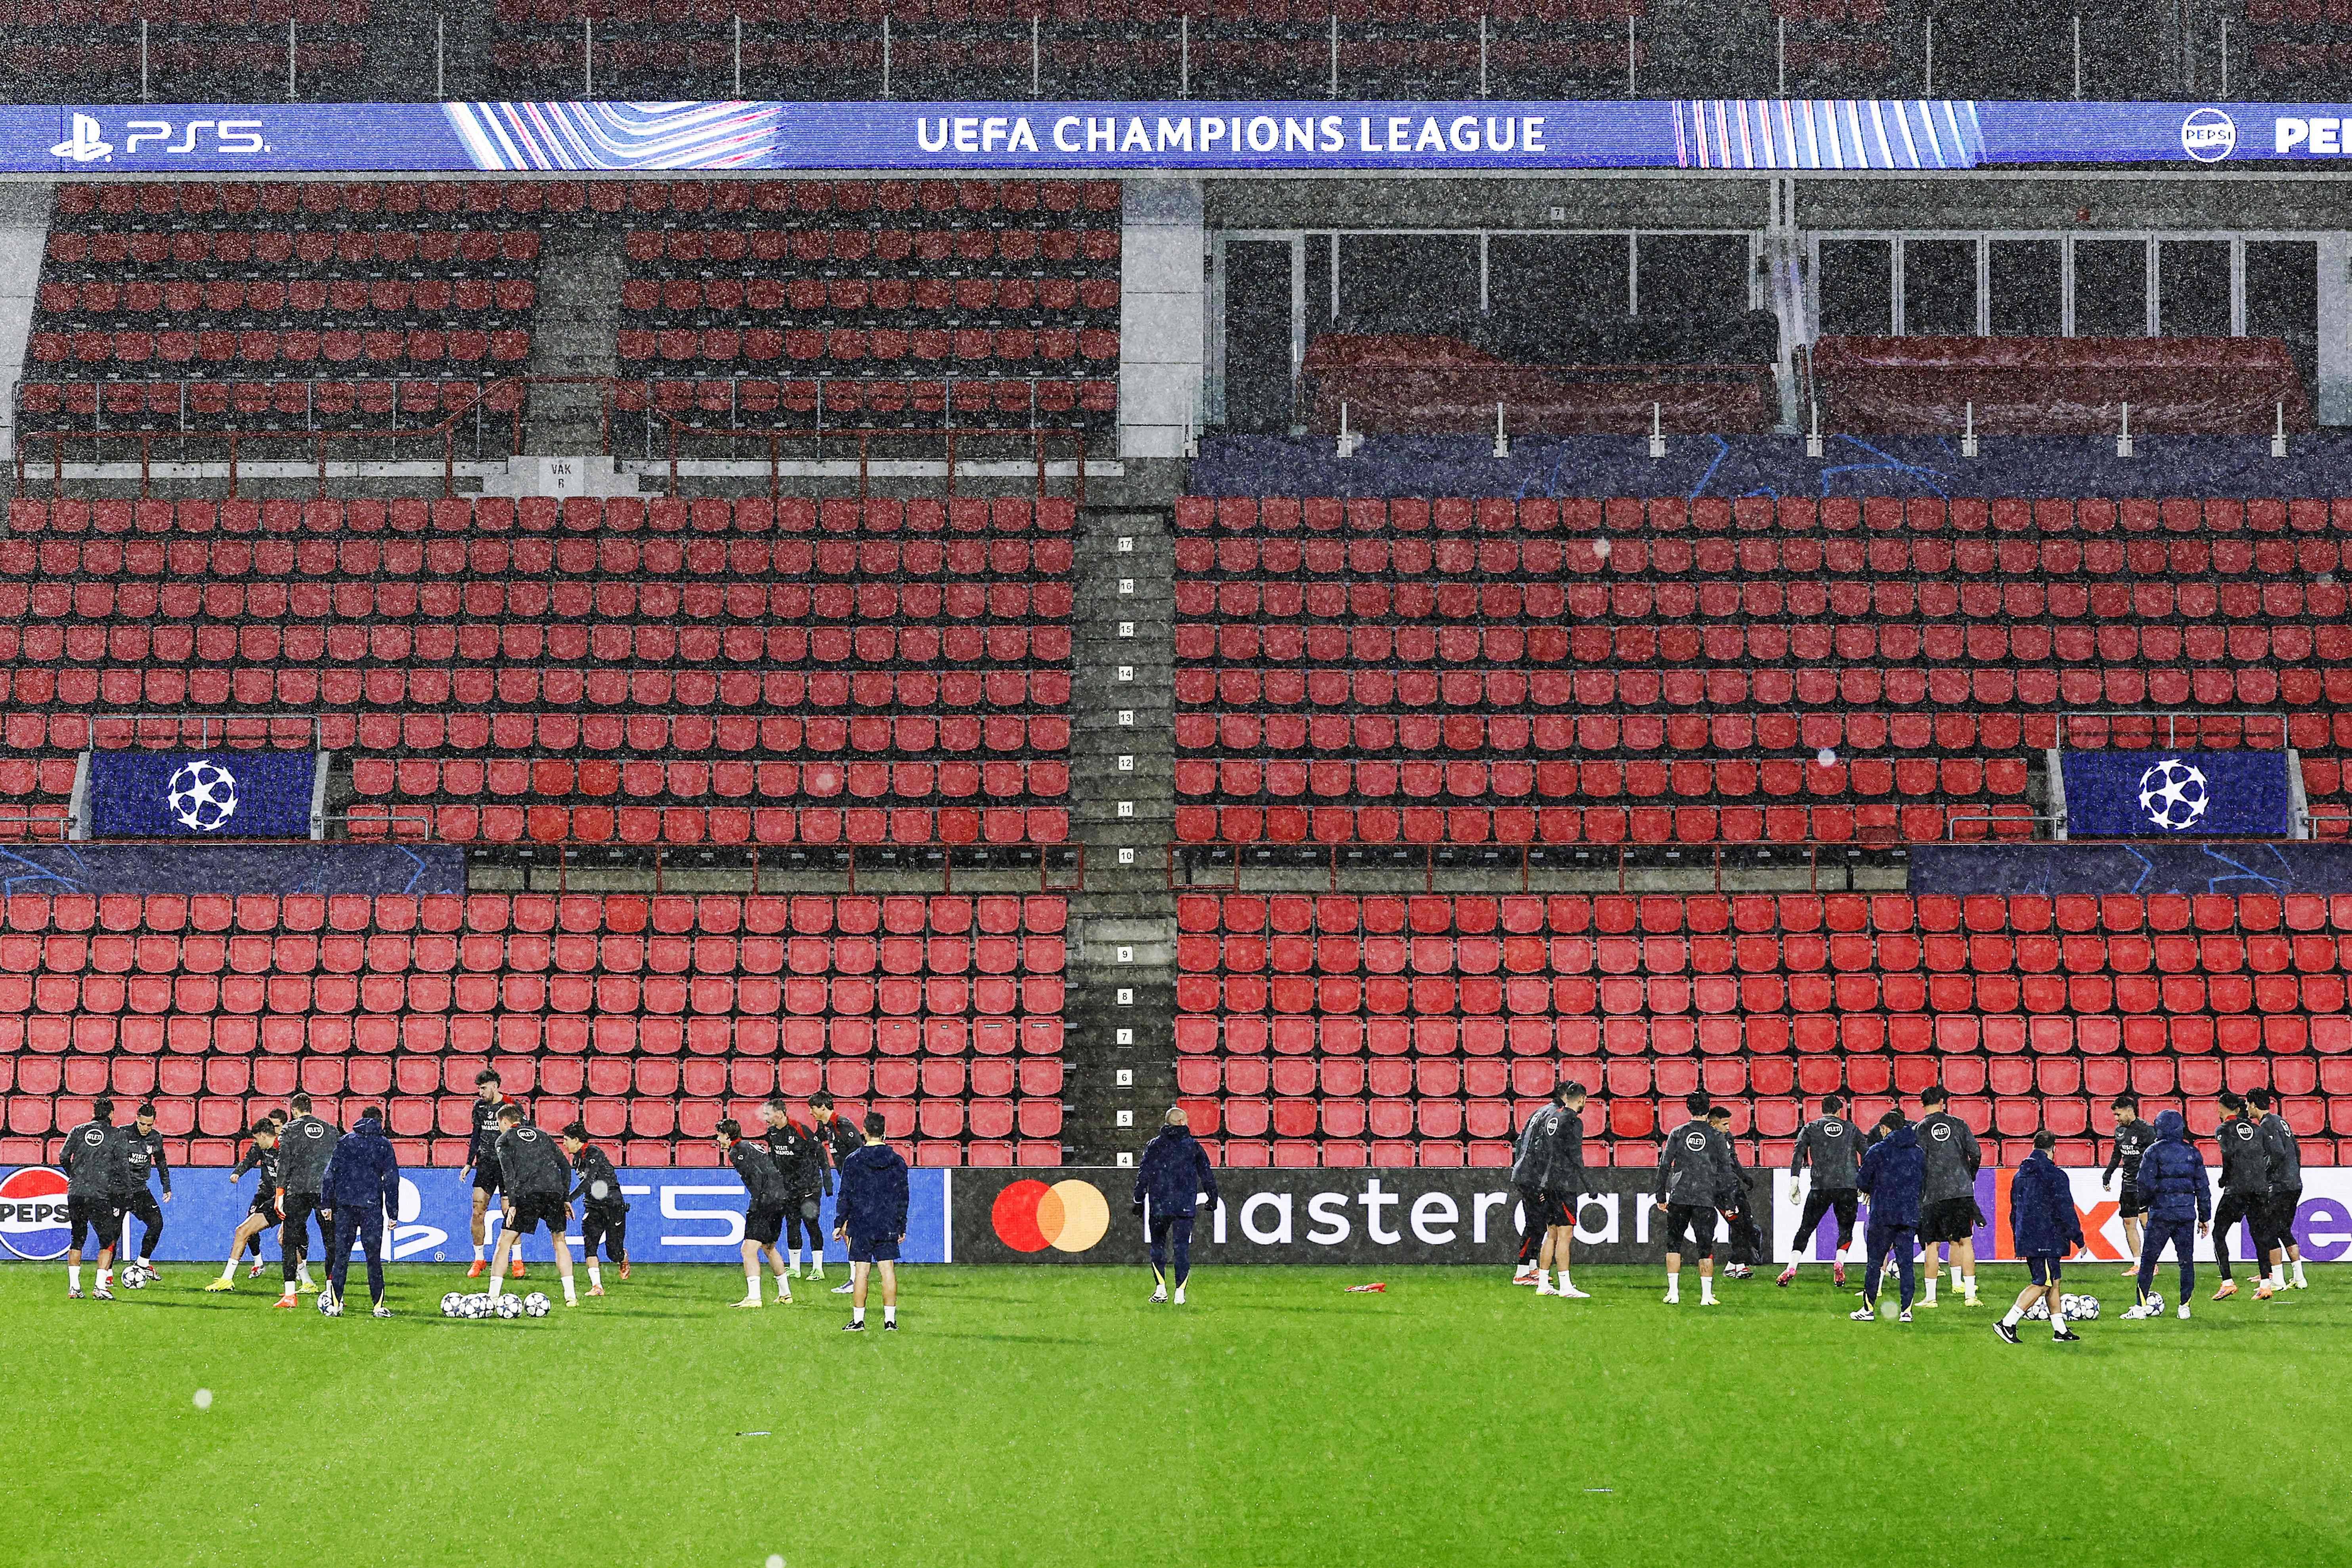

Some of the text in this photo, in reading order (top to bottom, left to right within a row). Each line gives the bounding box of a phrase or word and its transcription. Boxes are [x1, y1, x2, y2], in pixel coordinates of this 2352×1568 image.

[917, 115, 1549, 152] UEFA CHAMPIONS LEAGUE
[2186, 130, 2231, 140] PEPSI
[551, 464, 572, 474] VAK
[0, 1204, 71, 1223] PEPS
